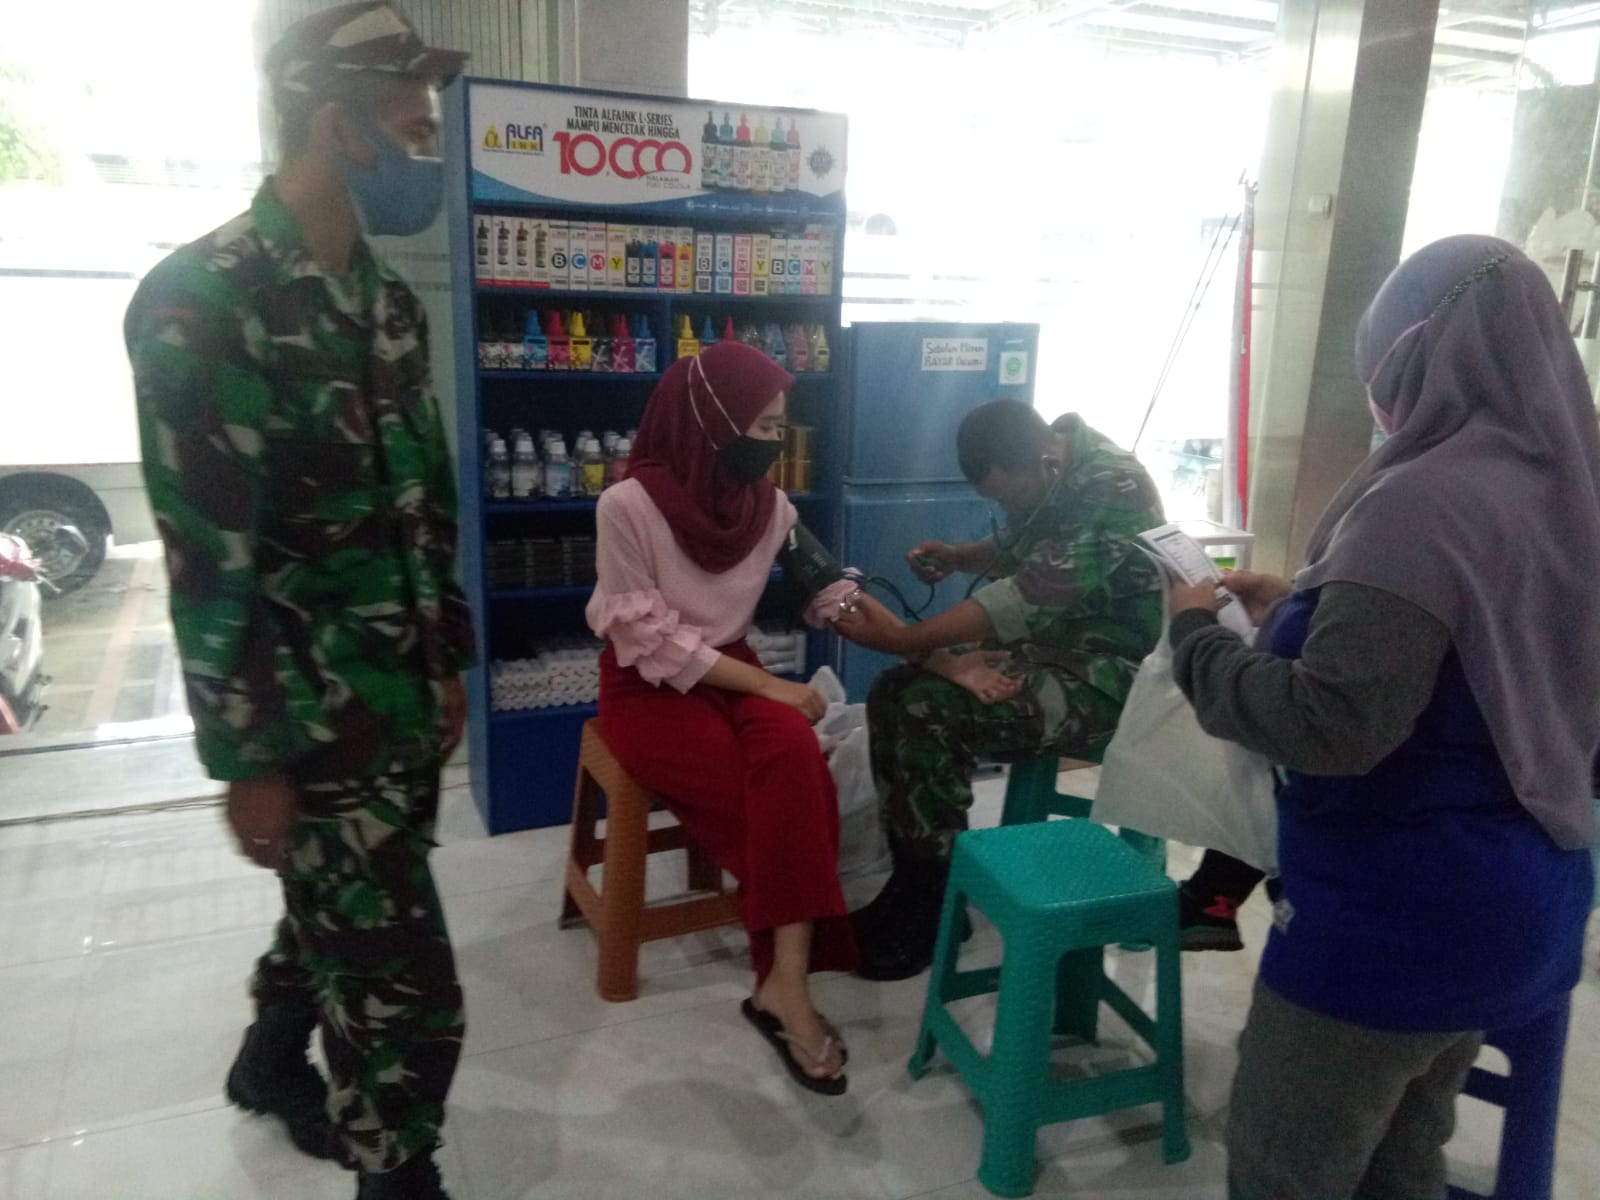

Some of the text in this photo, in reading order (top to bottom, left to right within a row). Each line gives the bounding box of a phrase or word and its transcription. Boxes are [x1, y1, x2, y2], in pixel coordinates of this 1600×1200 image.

[574, 105, 673, 126] TINTA ALFAINK L-SERIES
[506, 123, 543, 151] ALFA
[566, 117, 680, 138] MAMPU MENCETAK HINGGA
